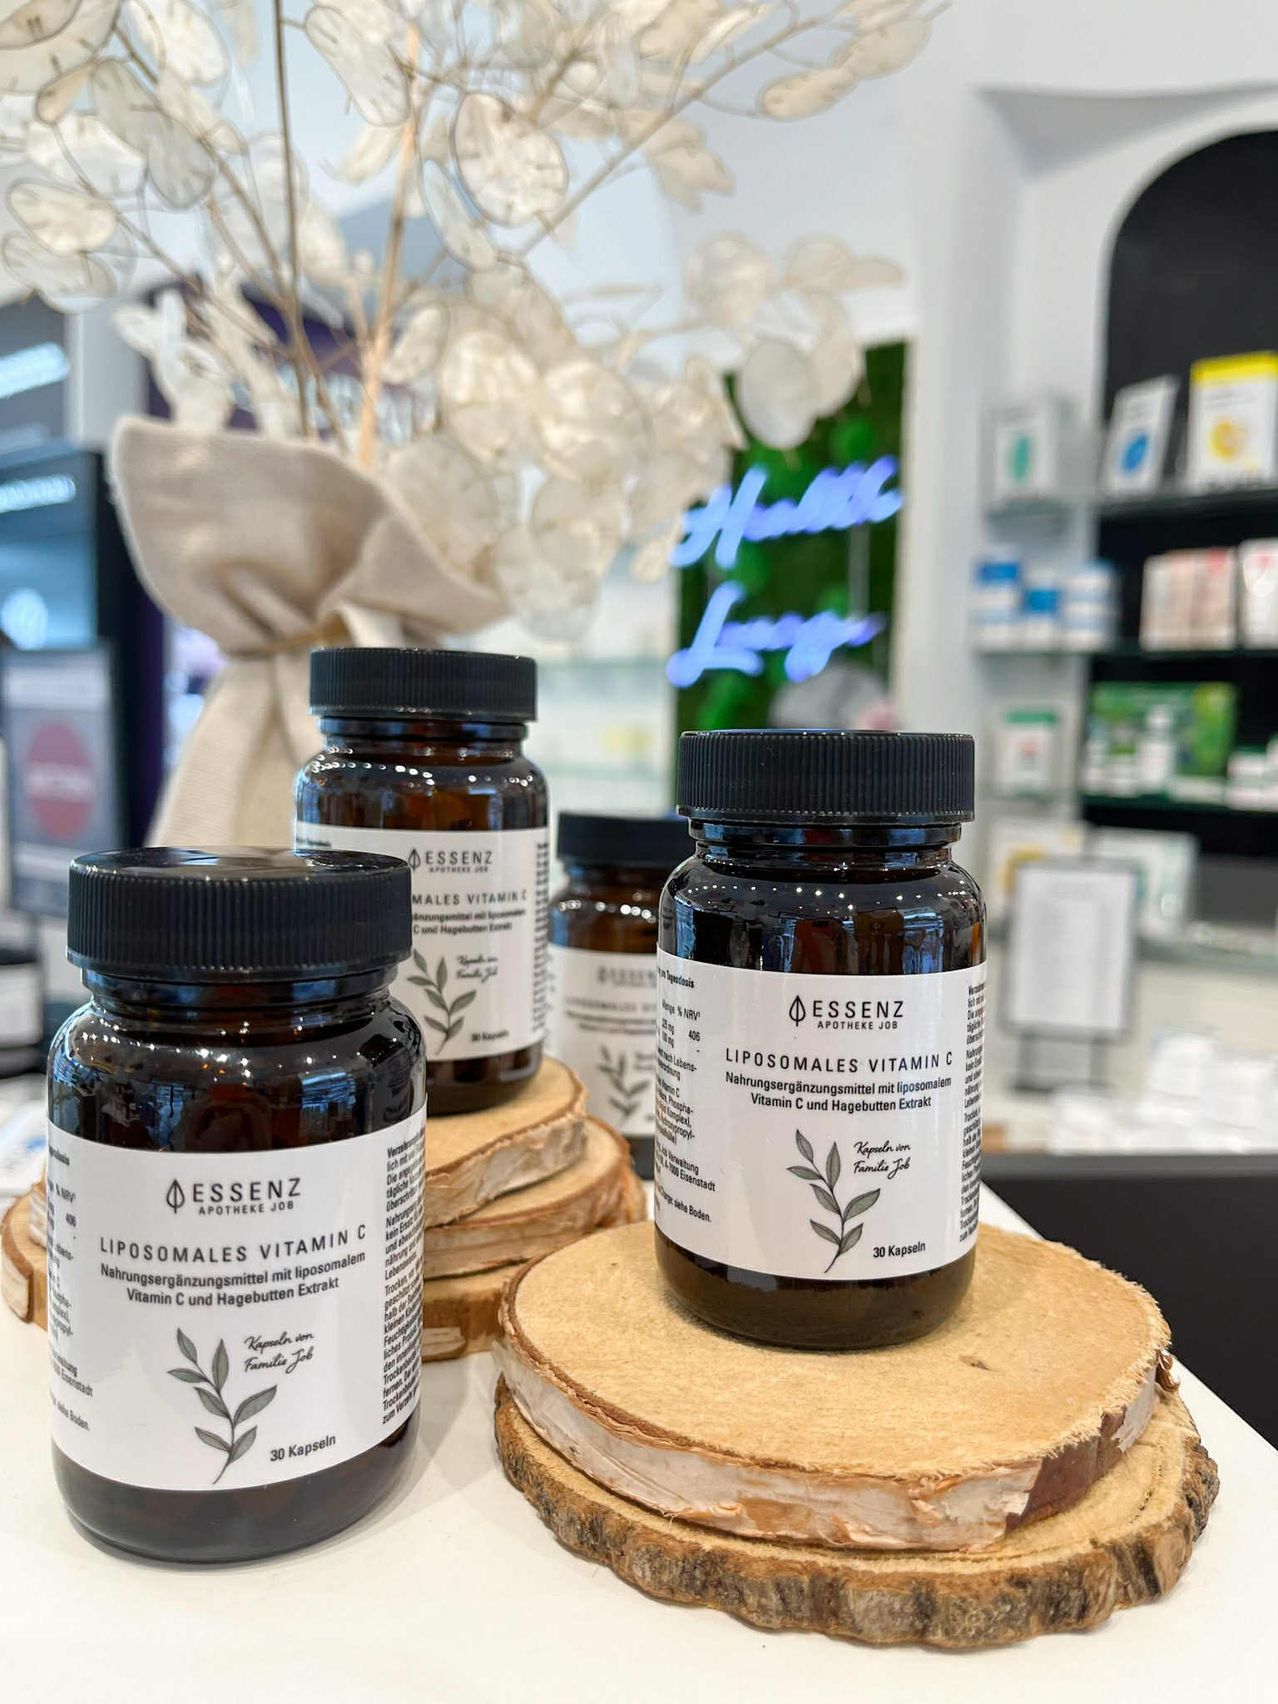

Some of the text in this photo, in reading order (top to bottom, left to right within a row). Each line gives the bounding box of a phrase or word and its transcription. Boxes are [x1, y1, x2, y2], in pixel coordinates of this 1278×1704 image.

[426, 850, 493, 865] ESSENZ
[467, 890, 518, 904] VITAMIN
[812, 1000, 904, 1018] ESSENZ
[818, 1020, 898, 1030] APOTHEKE JOB
[688, 1030, 700, 1042] 406
[726, 1048, 858, 1072] LIPOSOMALES
[868, 1054, 939, 1072] VITAMIN
[946, 1052, 952, 1065] C
[726, 1072, 952, 1096] Nahrungsergänzungsmittel mit liposomalem
[751, 1093, 931, 1114] Vitamin C und Hagebutten Extrakt
[854, 1140, 911, 1156] Kapseln von
[854, 1157, 911, 1180] Familie Job
[387, 1174, 397, 1186] Die
[680, 1169, 716, 1192] Eisenstadt
[193, 1178, 301, 1203] ESSENZ
[199, 1202, 294, 1216] APOTHEKE JOB
[689, 1204, 712, 1222] Boden.
[100, 1224, 366, 1263] LIPOSOMALES VITAMIN C
[873, 1242, 926, 1258] 30 Kapseln
[100, 1251, 366, 1290] Nahrungsergänzungsmittel mit liposomalem
[126, 1278, 339, 1308] Vitamin C und Hagebutten Extrakt
[244, 1331, 314, 1351] Kapseln von
[244, 1346, 314, 1375] Familie Job
[270, 1434, 336, 1462] 30 Kapseln
